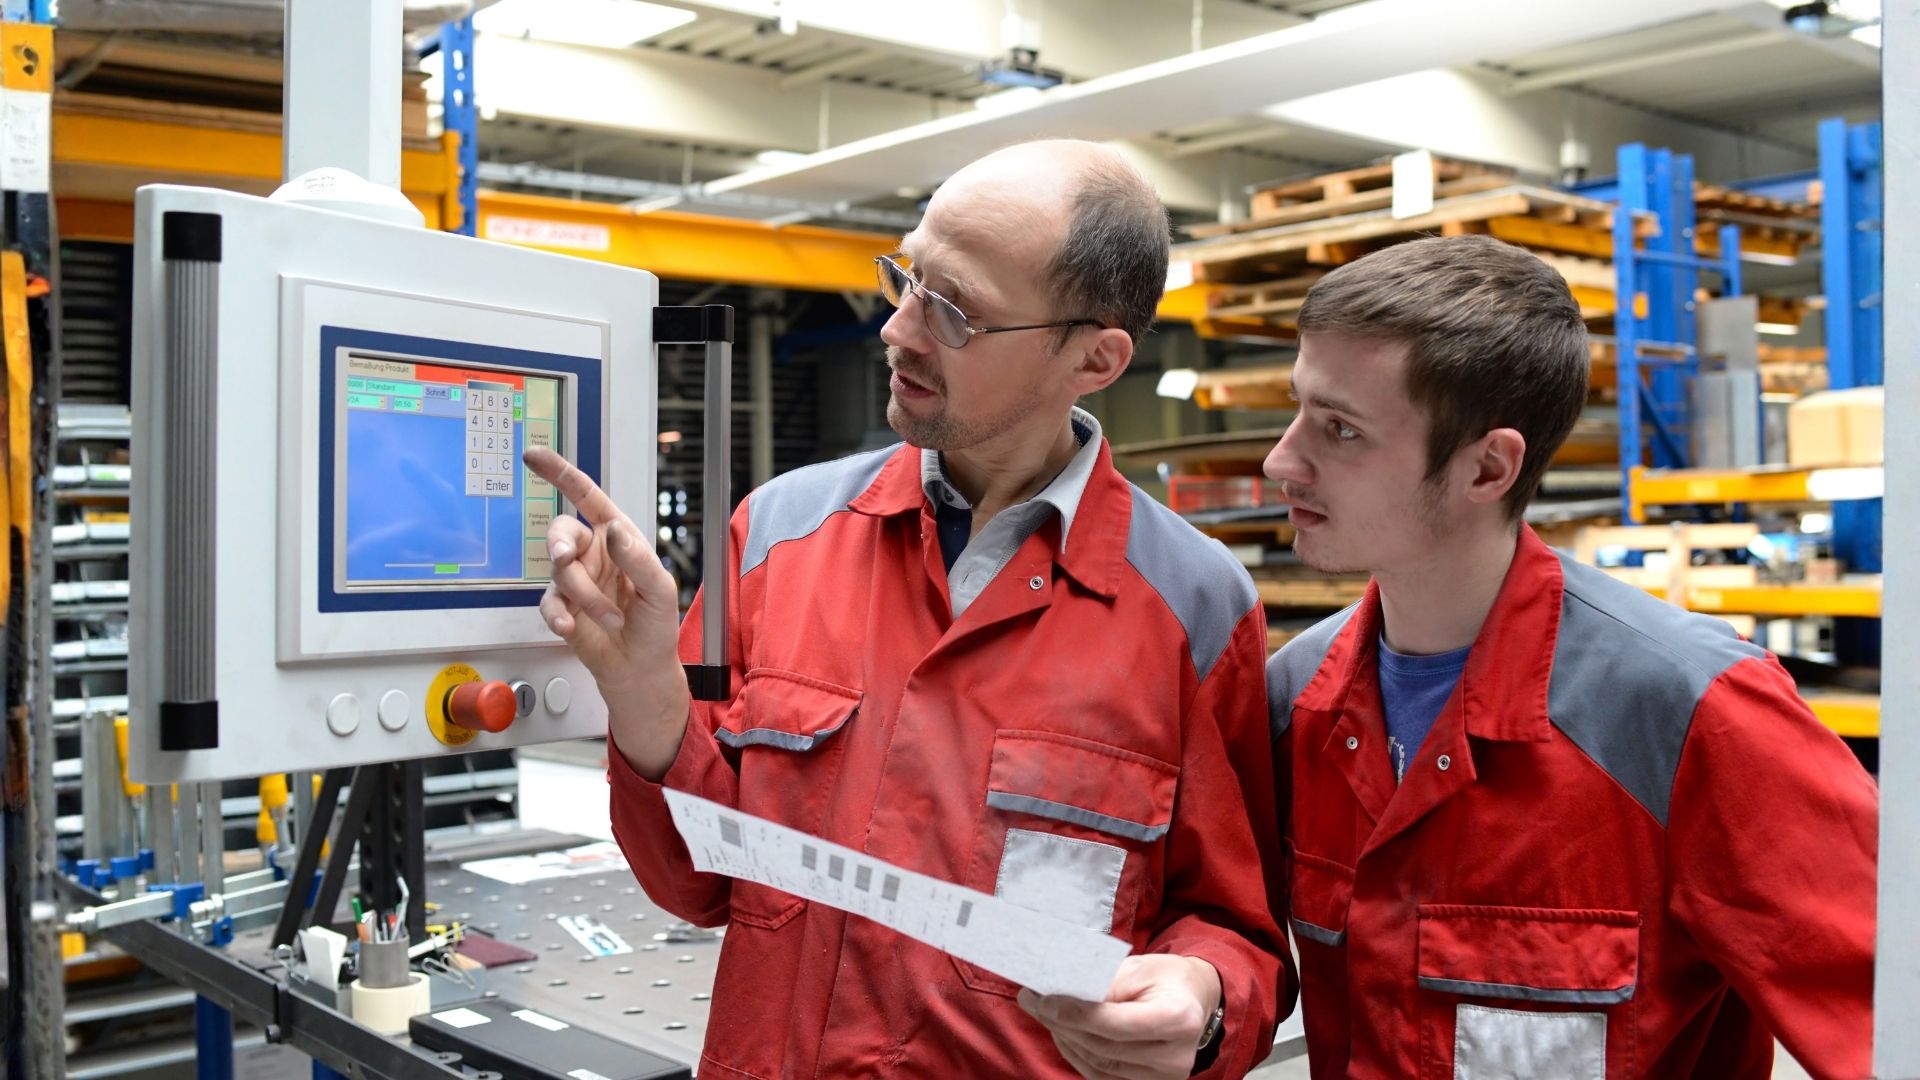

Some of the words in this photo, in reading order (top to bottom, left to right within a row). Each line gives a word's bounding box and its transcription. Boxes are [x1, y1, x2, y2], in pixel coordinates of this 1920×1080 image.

[472, 393, 478, 405] 7
[487, 395, 494, 407] 8
[502, 397, 509, 408] 9
[471, 415, 478, 427] 4
[487, 416, 494, 428] 5
[502, 418, 509, 429] 6
[487, 437, 494, 449] 2
[502, 438, 509, 449] 3
[471, 458, 478, 469] 0
[502, 459, 510, 471] C
[485, 479, 510, 491] Enter
